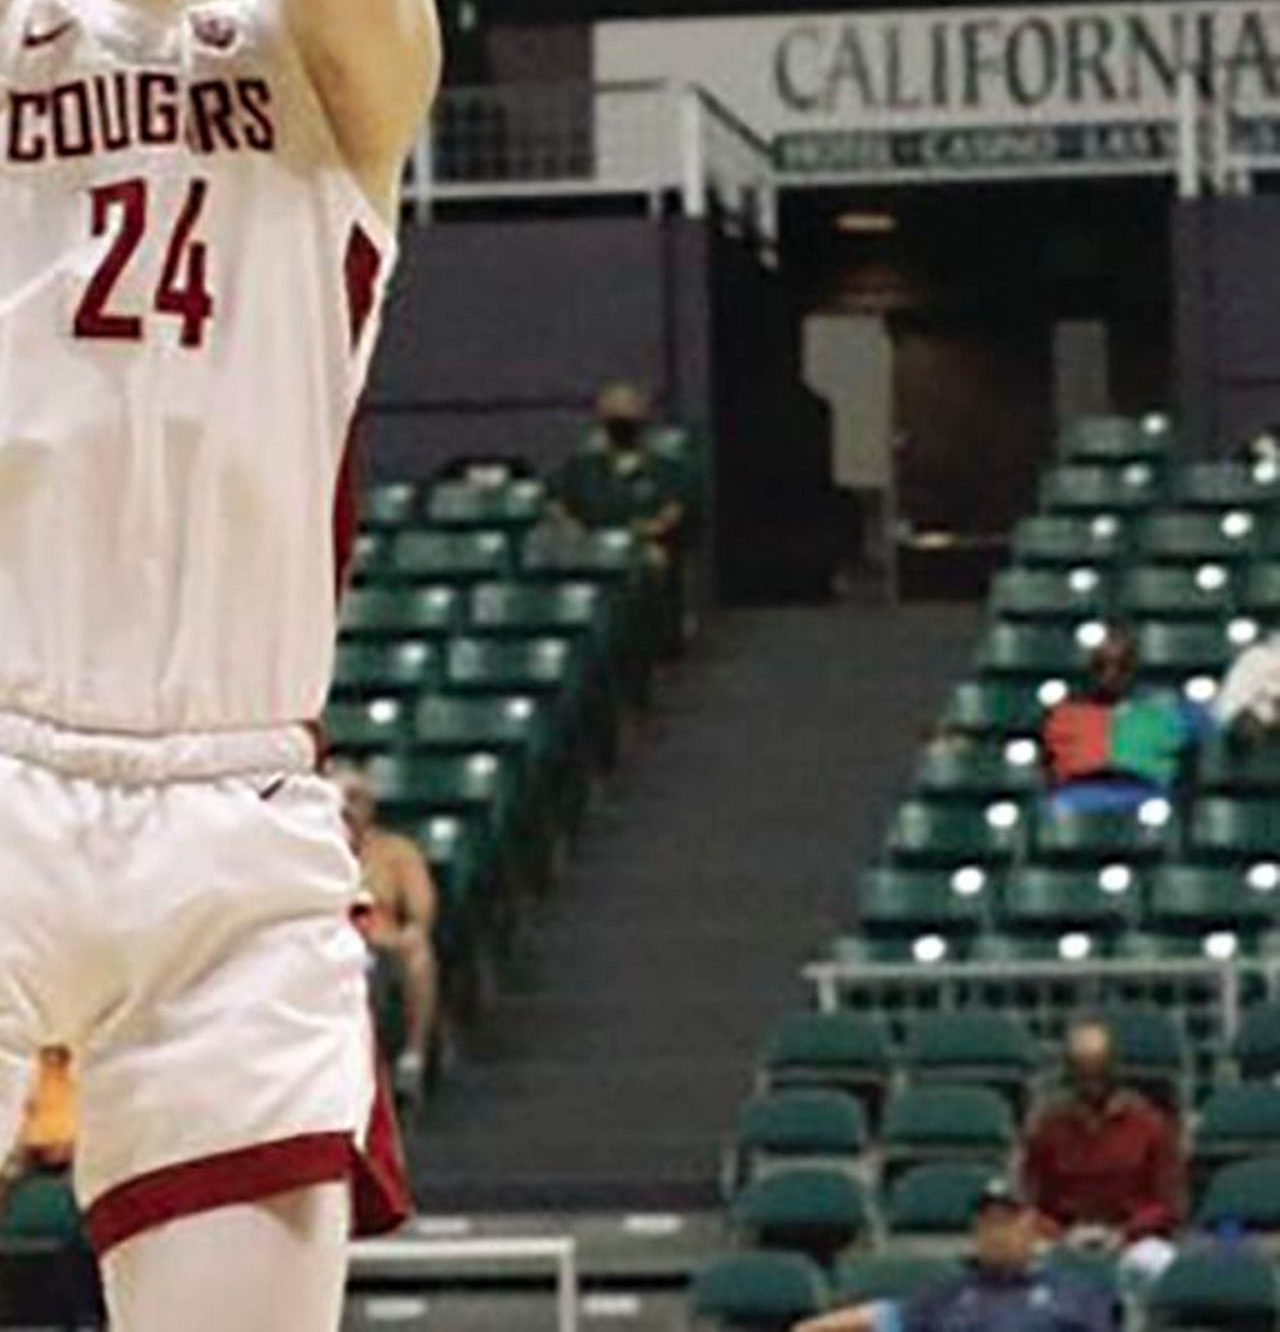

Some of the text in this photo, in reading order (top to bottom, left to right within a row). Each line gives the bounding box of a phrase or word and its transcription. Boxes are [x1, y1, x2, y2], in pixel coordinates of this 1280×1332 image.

[774, 8, 1280, 111] CALIFORNIA
[6, 71, 276, 163] COUGRS
[73, 176, 213, 348] 24
